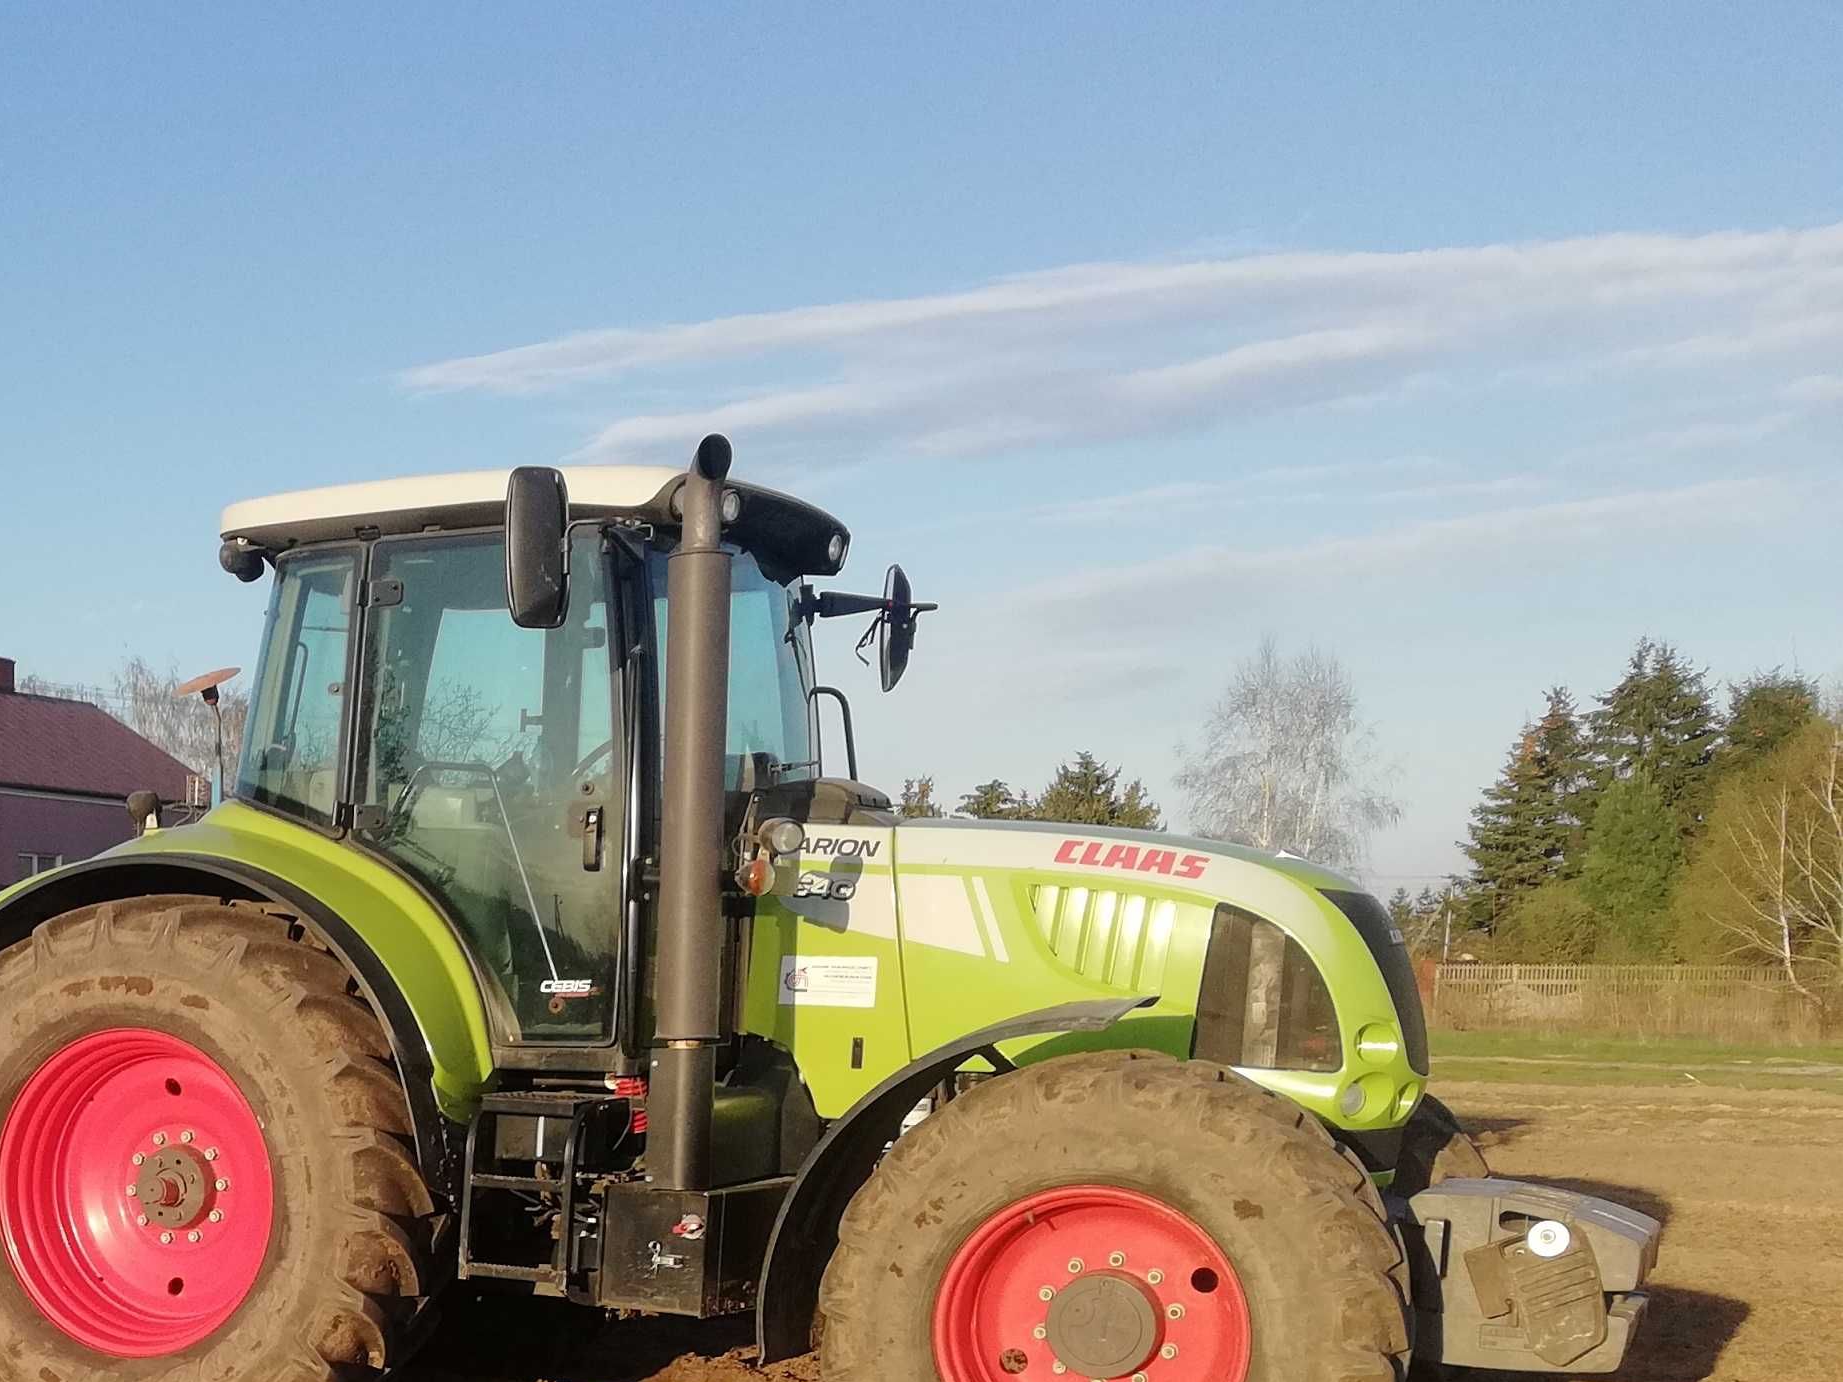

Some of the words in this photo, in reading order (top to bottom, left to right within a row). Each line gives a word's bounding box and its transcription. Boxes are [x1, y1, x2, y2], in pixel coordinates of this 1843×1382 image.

[797, 837, 881, 857] ARION
[1054, 840, 1211, 879] CLAAS
[540, 979, 592, 993] CEBIS
